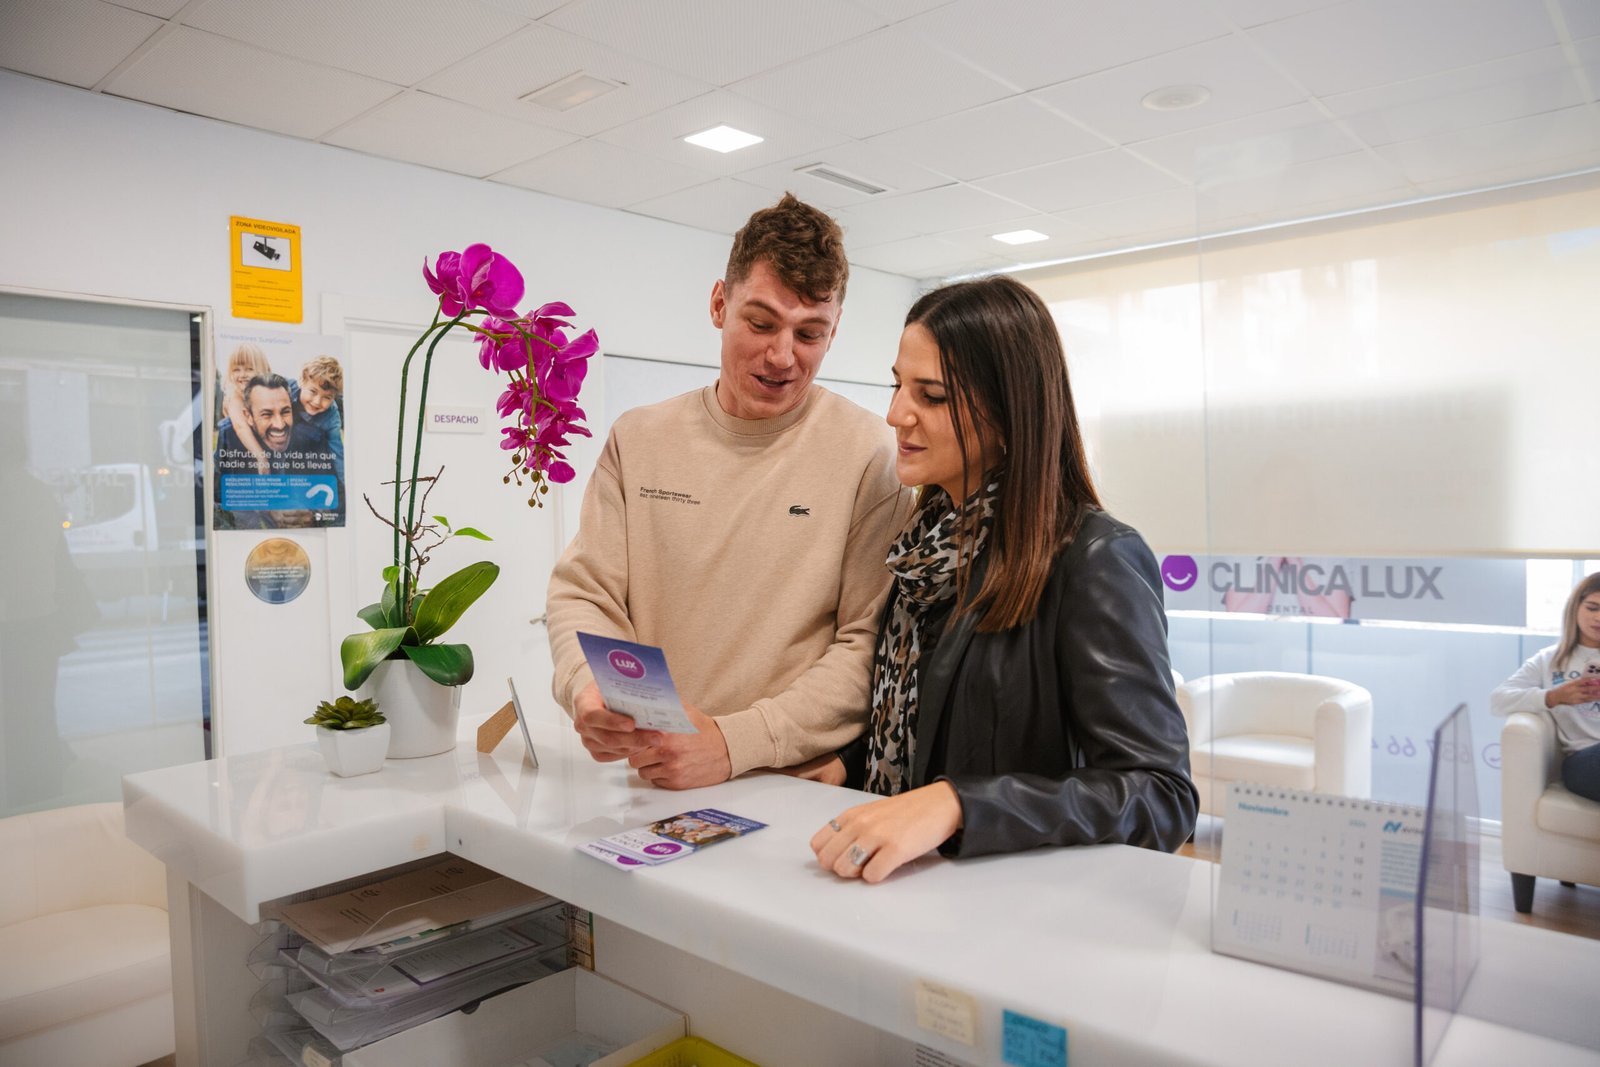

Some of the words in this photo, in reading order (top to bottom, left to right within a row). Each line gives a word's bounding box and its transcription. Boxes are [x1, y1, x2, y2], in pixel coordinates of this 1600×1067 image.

[254, 224, 296, 234] VIDEOVIGILADA
[434, 414, 478, 424] DESPACHO
[220, 449, 256, 459] Disfruta
[258, 450, 271, 459] de
[274, 450, 282, 460] la
[284, 450, 302, 460] vida
[306, 452, 318, 460] sin
[319, 453, 336, 462] que
[220, 460, 245, 468] nadie
[248, 462, 270, 471] sepa
[272, 461, 290, 471] que
[292, 460, 305, 470] los
[308, 461, 332, 470] llevas
[658, 489, 692, 498] Sportswear
[1208, 556, 1352, 596] CLÍNICA
[1361, 565, 1444, 600] LUX
[614, 658, 637, 670] LUX
[1238, 802, 1290, 816] Noviembre
